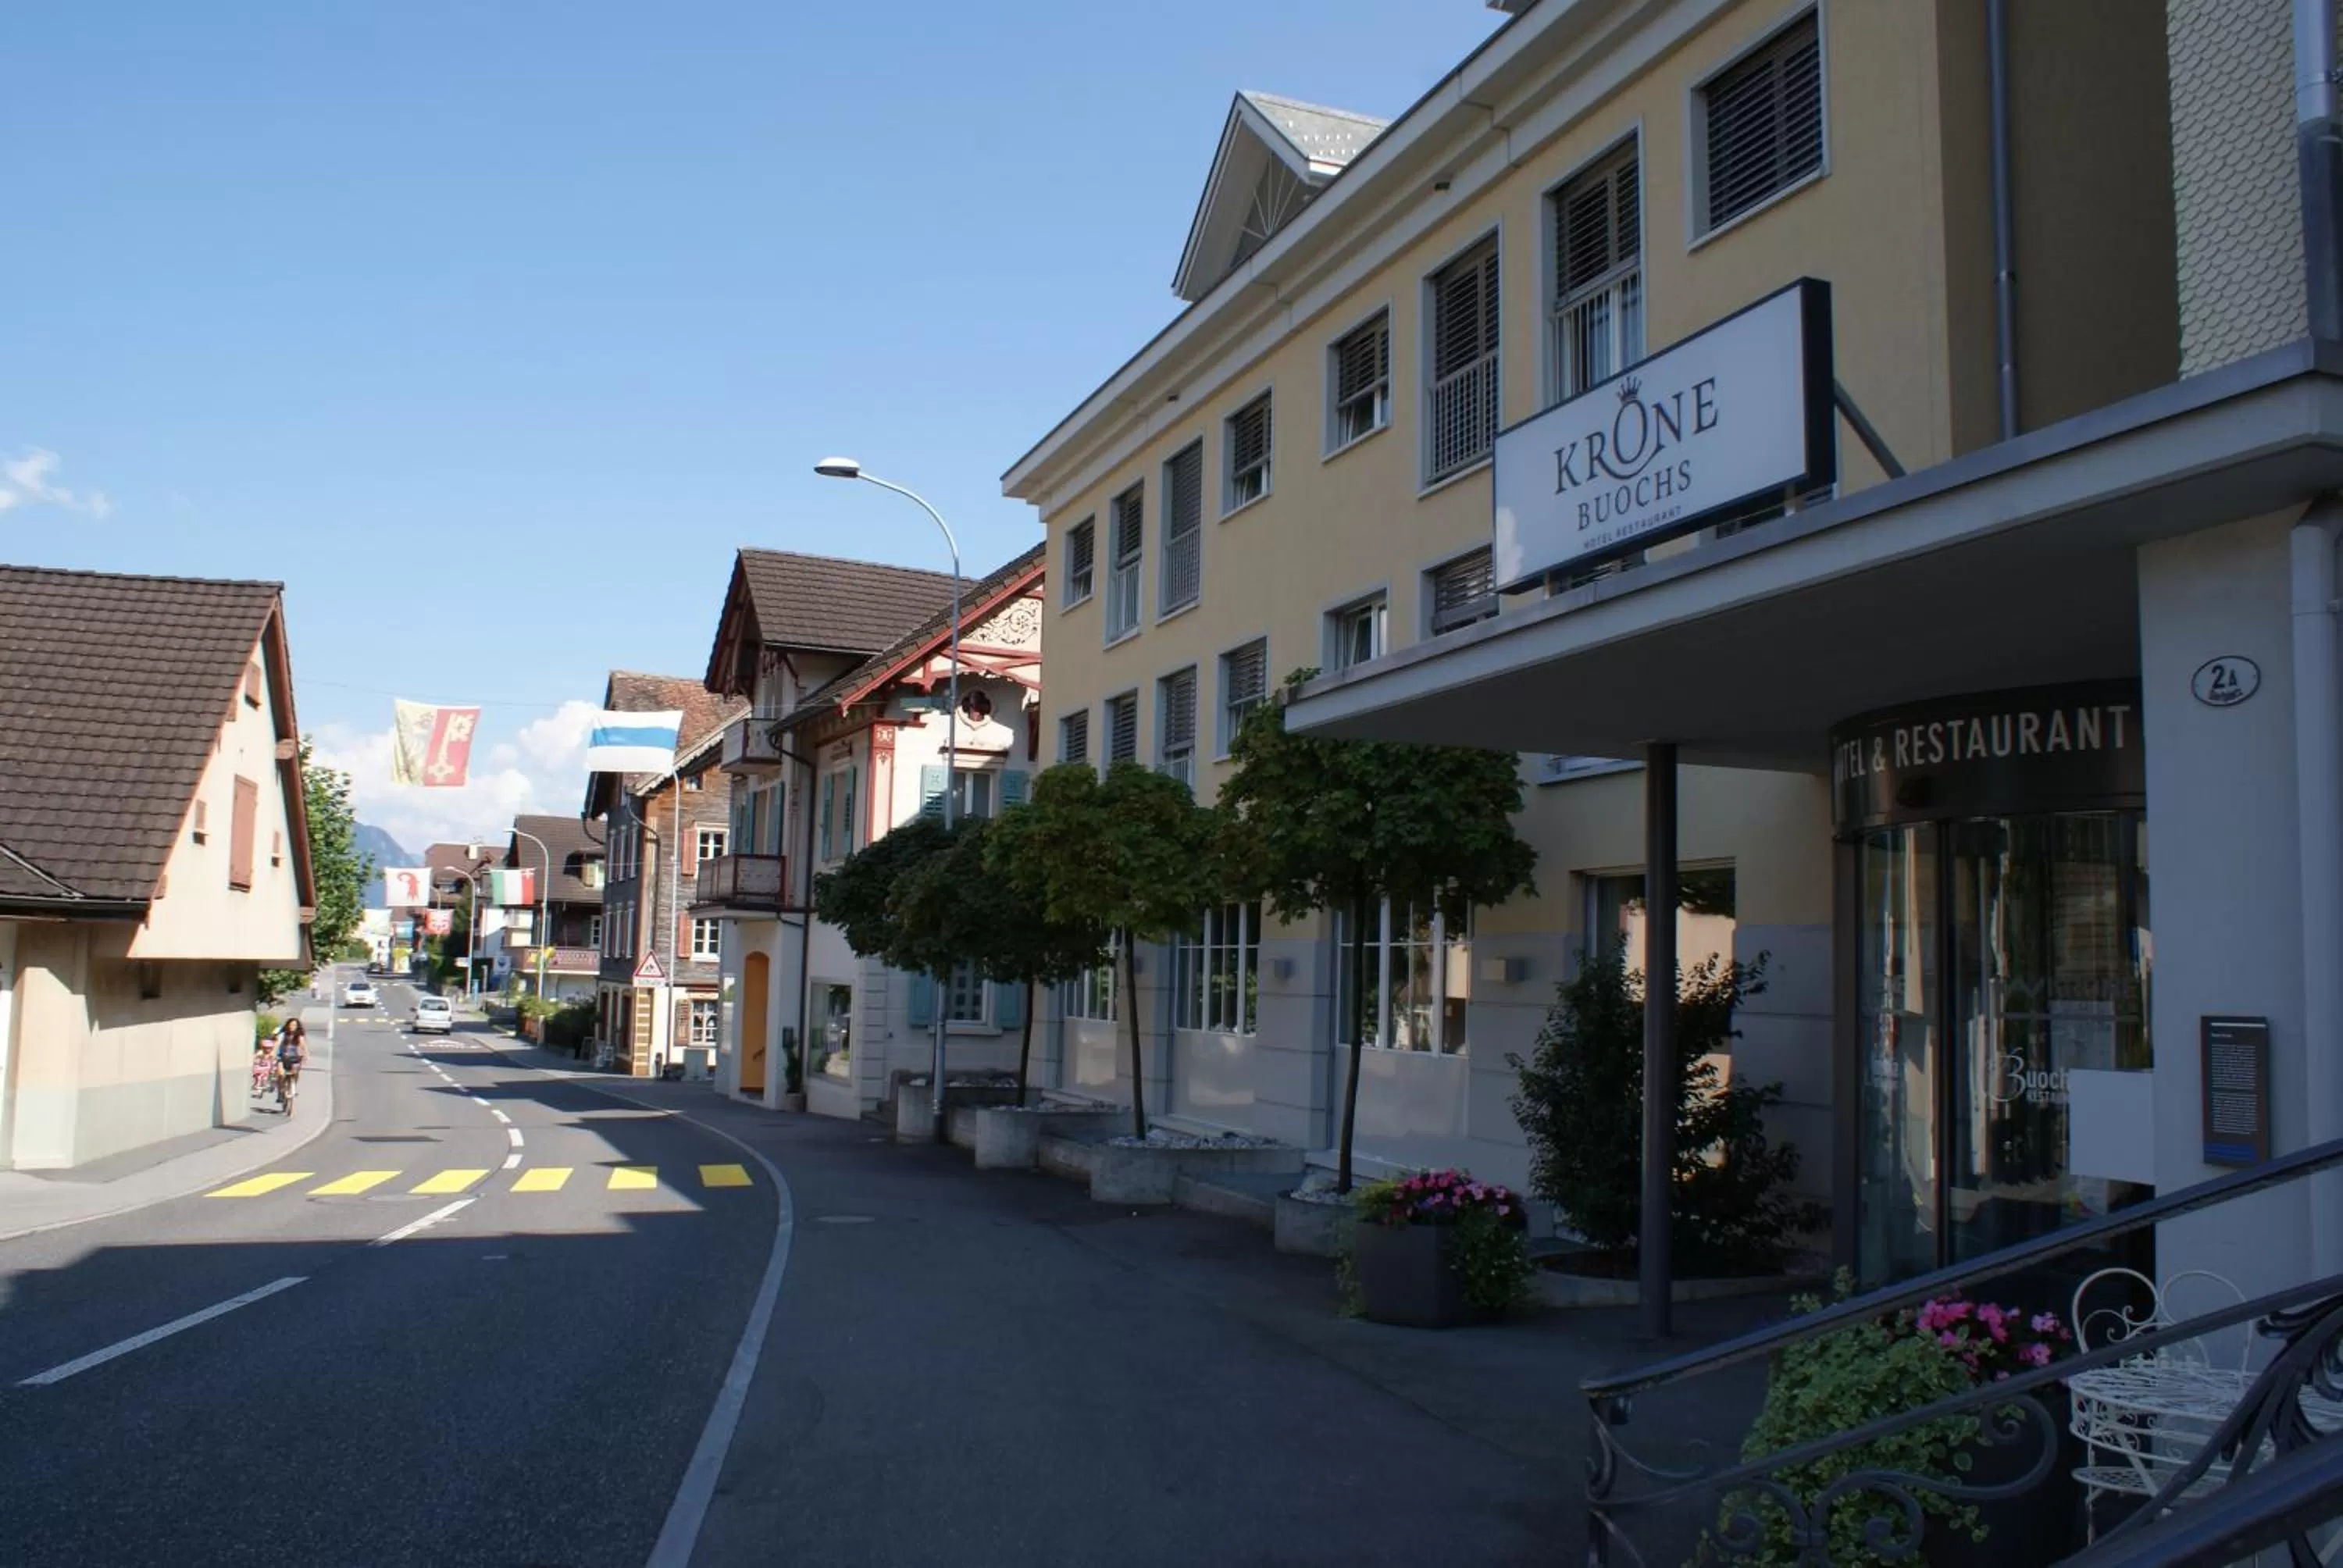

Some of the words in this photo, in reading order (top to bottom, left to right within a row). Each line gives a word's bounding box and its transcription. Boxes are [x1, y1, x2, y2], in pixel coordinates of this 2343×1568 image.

[1553, 376, 1719, 495] KRONE
[1578, 458, 1691, 531] BUOCHS
[1616, 505, 1681, 537] RESTAURANT
[1872, 736, 1886, 773] &
[1895, 705, 2131, 769] RESTAURANT
[1984, 1046, 2069, 1103] Buoch
